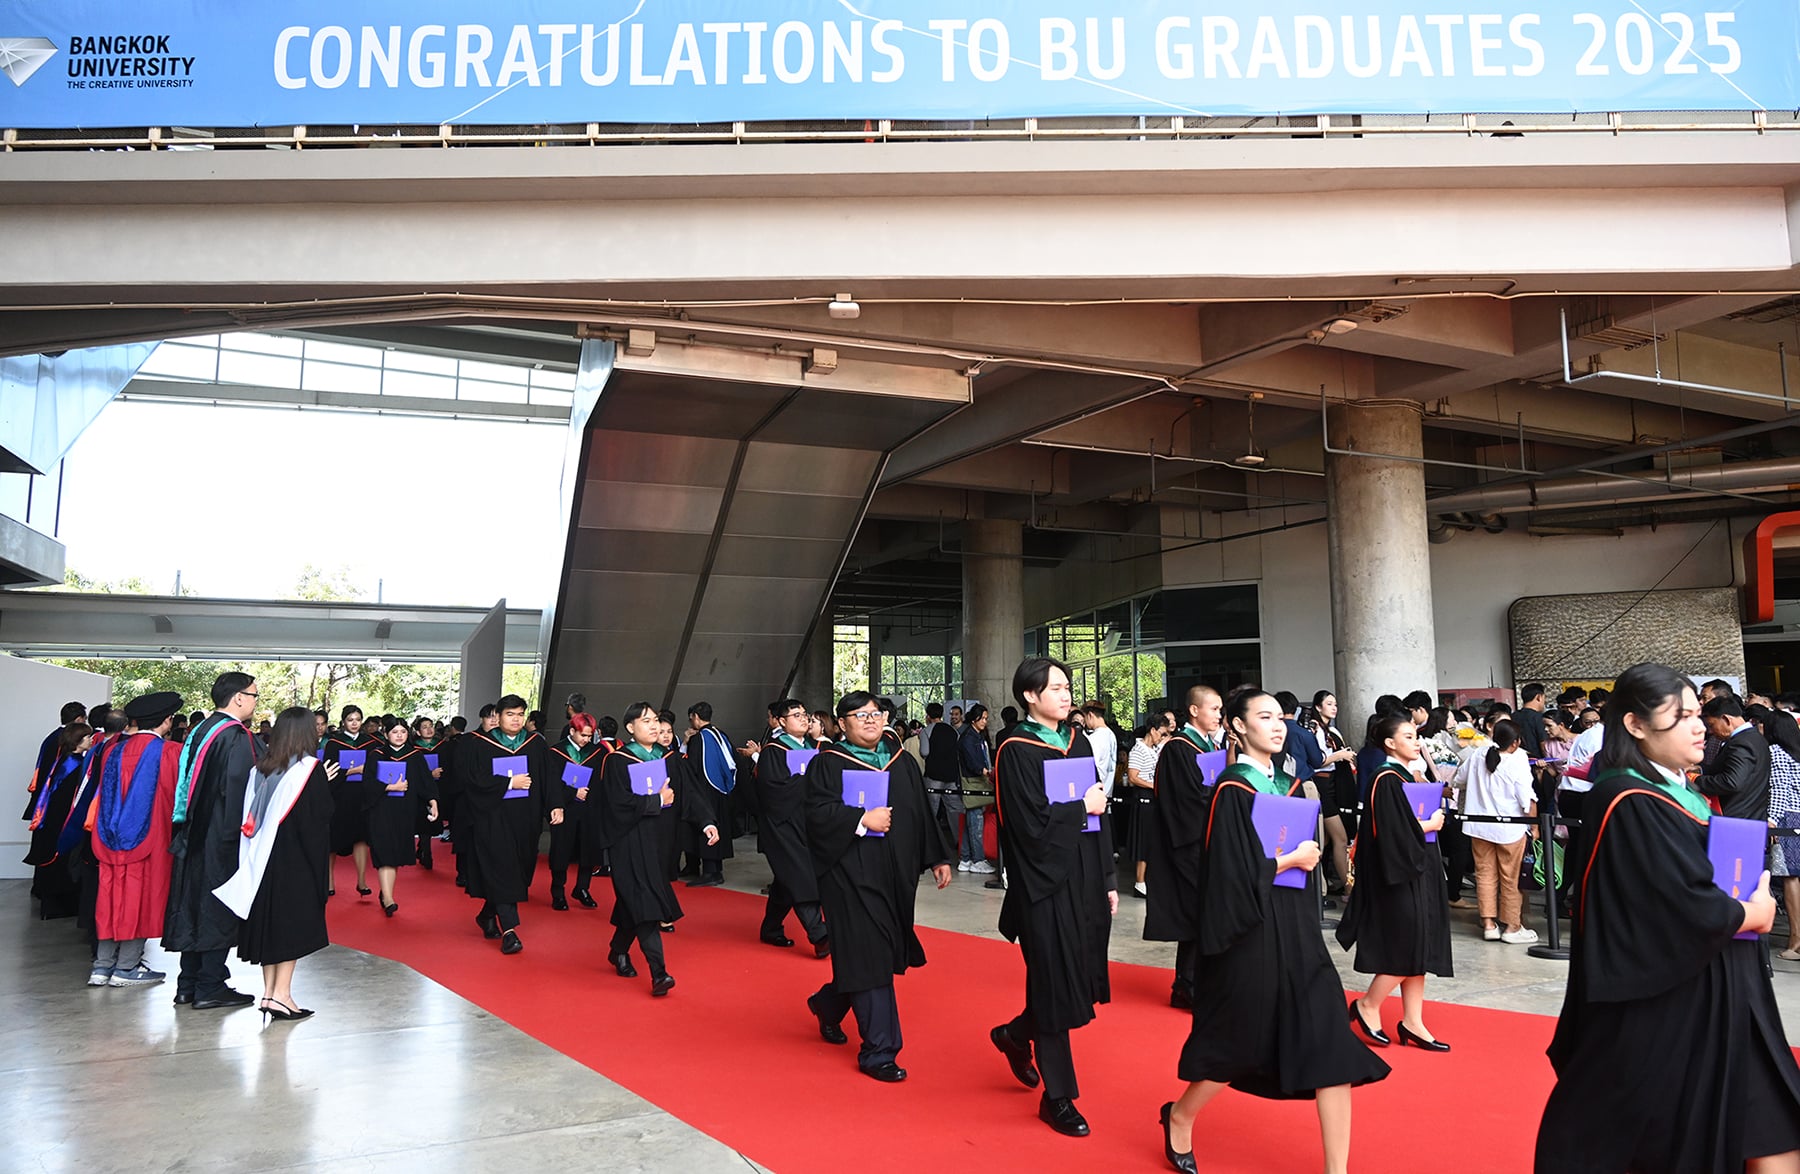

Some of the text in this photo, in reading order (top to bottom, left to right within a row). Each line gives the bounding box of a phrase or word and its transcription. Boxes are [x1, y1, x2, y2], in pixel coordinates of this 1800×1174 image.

[69, 35, 170, 55] BANGKOK
[273, 11, 1742, 90] CONGRATULATIONS TO BU GRADUATES 2025
[67, 57, 196, 78] UNIVERSITY
[67, 79, 194, 89] THE CREATIVE UNIVERSITY
